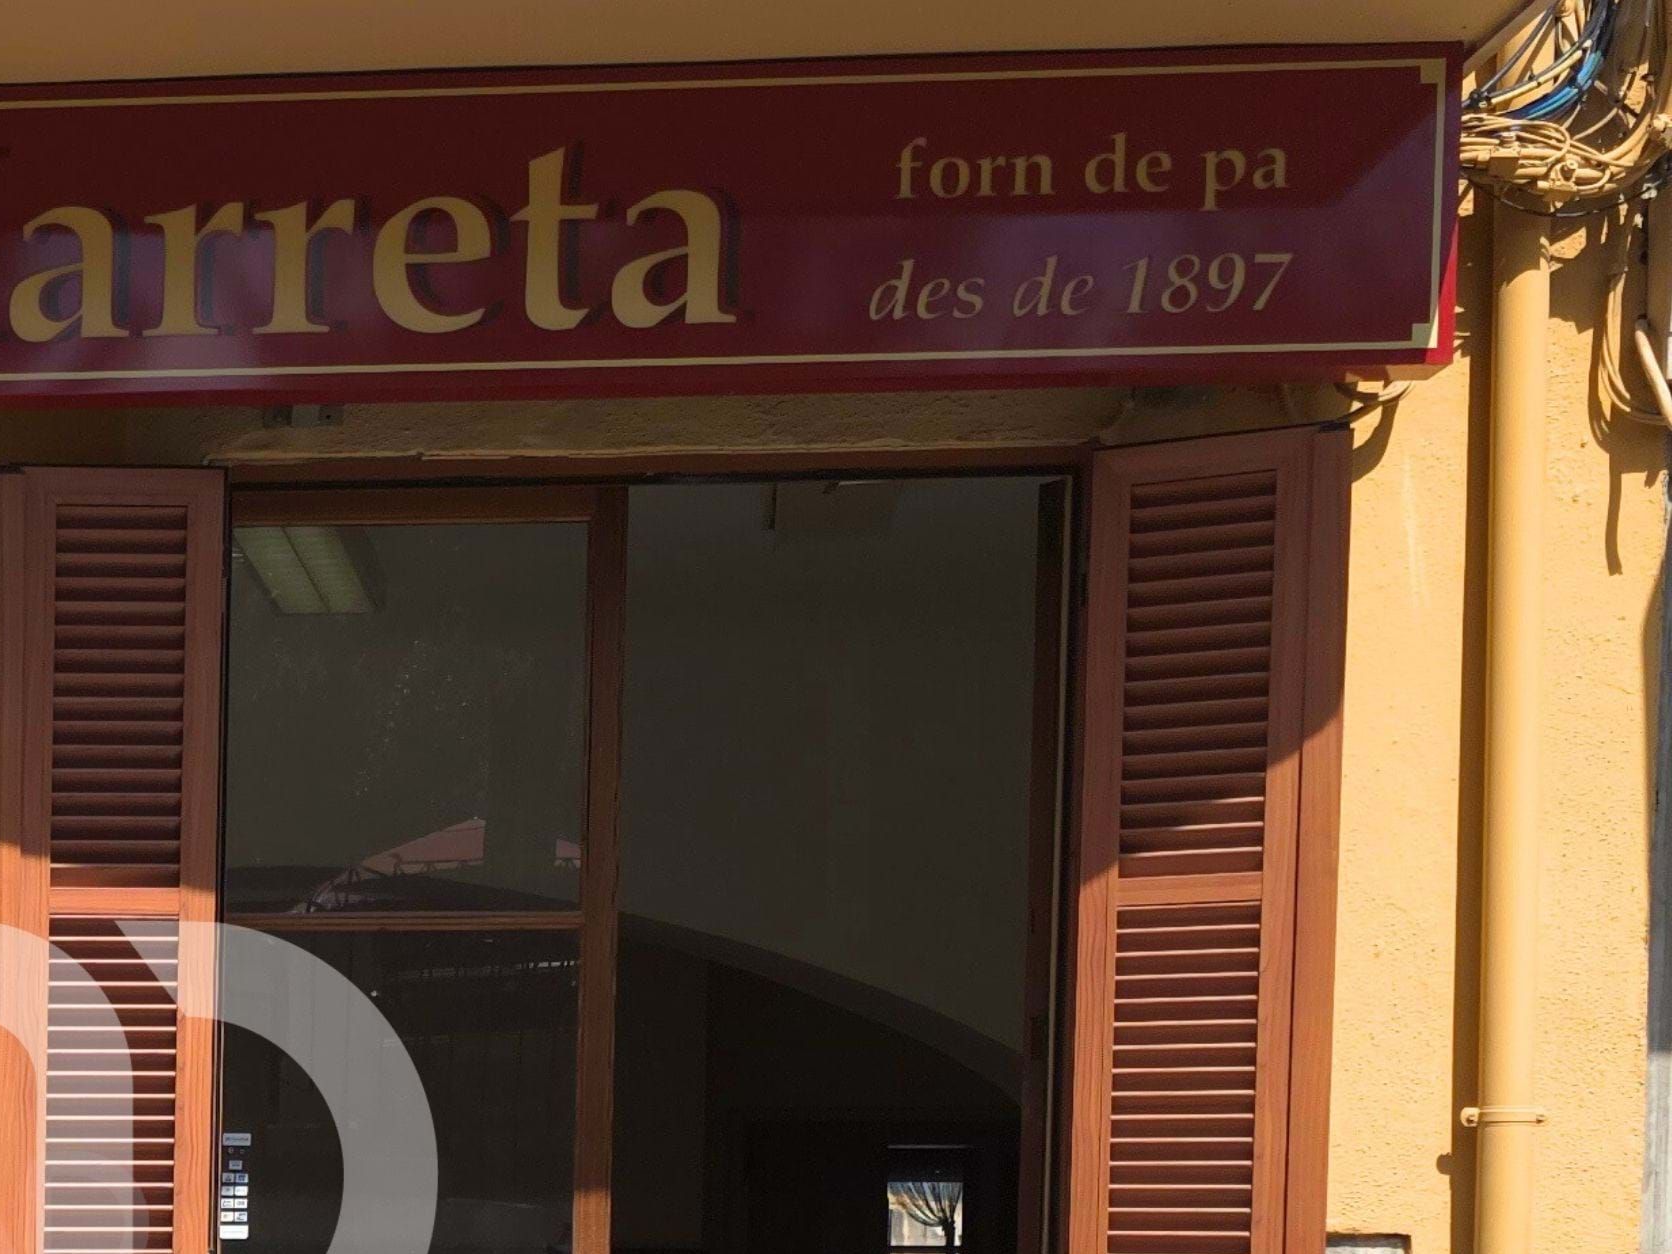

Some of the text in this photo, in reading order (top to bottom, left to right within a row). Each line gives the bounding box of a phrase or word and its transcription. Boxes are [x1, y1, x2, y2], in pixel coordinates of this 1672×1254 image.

[895, 132, 1288, 212] forn de pa
[868, 252, 1294, 320] des de 1897
